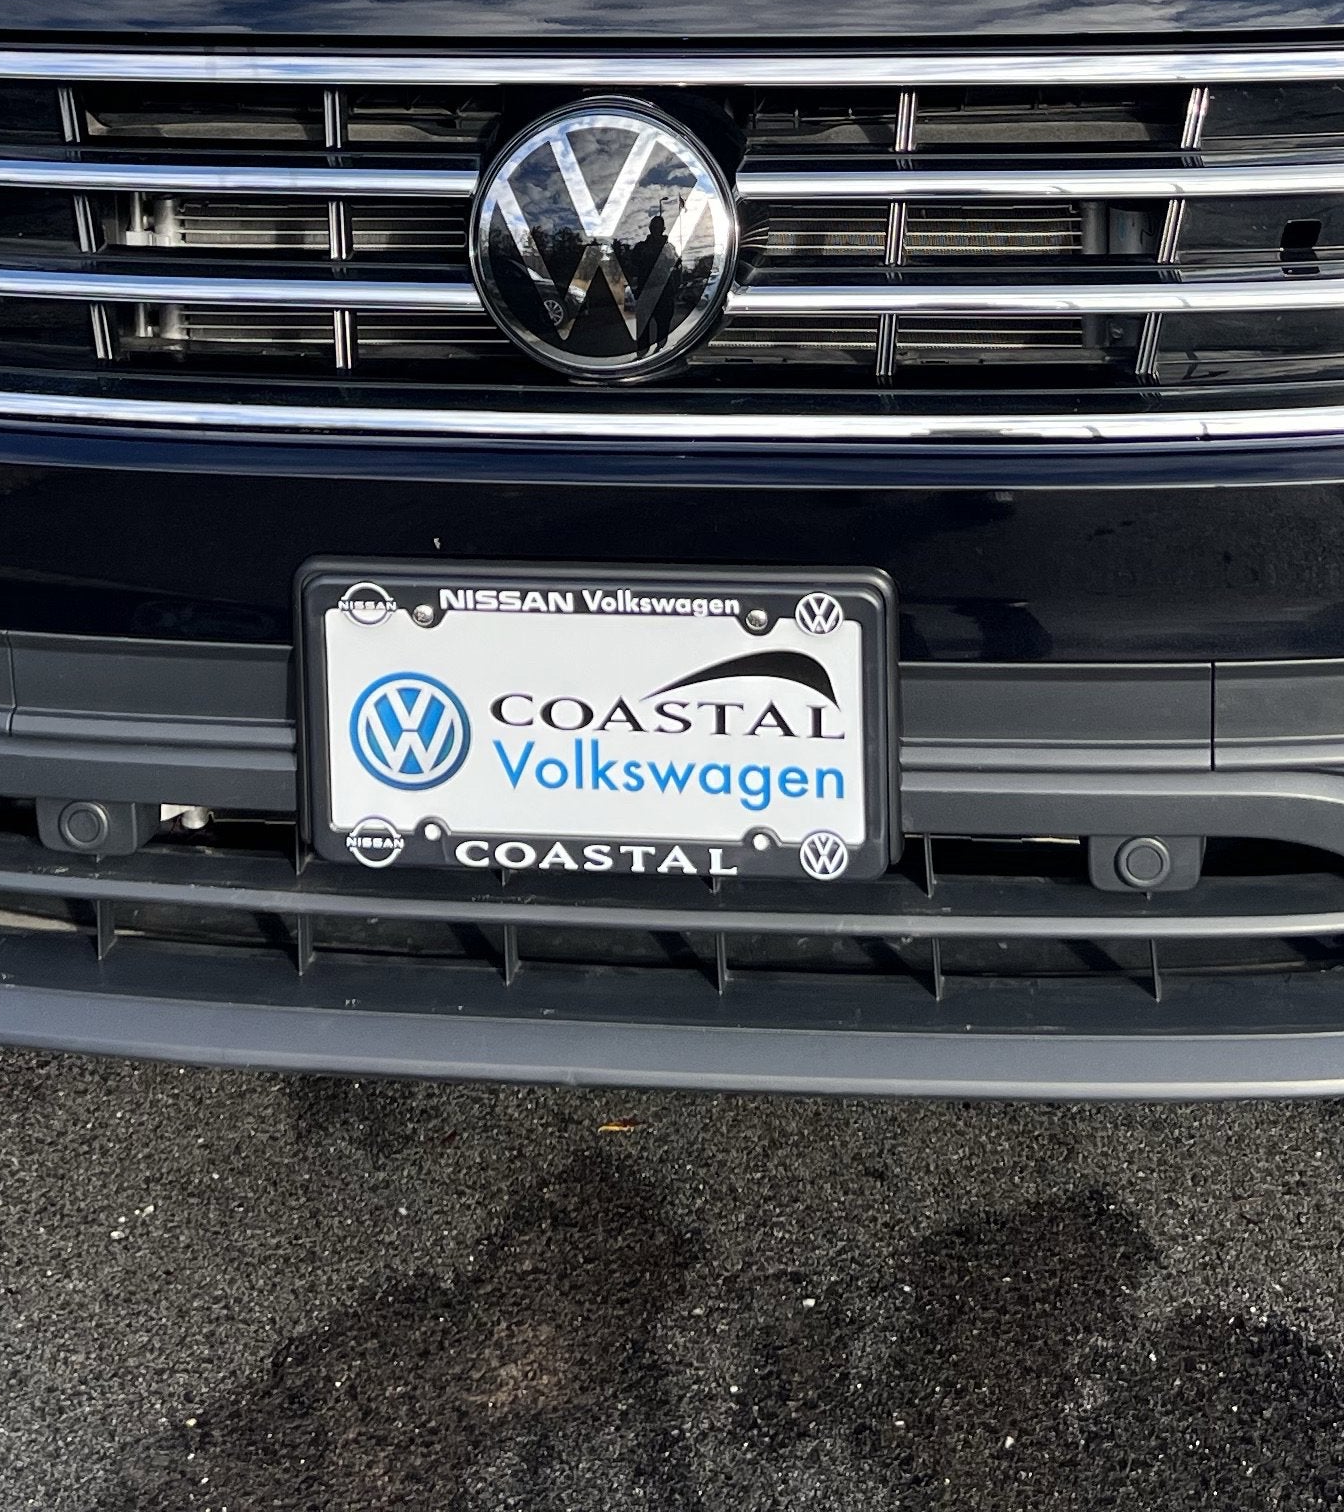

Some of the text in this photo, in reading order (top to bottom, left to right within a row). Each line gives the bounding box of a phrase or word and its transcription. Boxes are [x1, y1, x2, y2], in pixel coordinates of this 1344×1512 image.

[338, 600, 397, 610] NISSAN
[439, 588, 740, 617] NISSAN Volkswagen
[489, 693, 846, 740] COASTAL
[493, 738, 845, 811] Volkswagen
[346, 836, 405, 849] NISSAN
[455, 840, 738, 876] COASTAL
